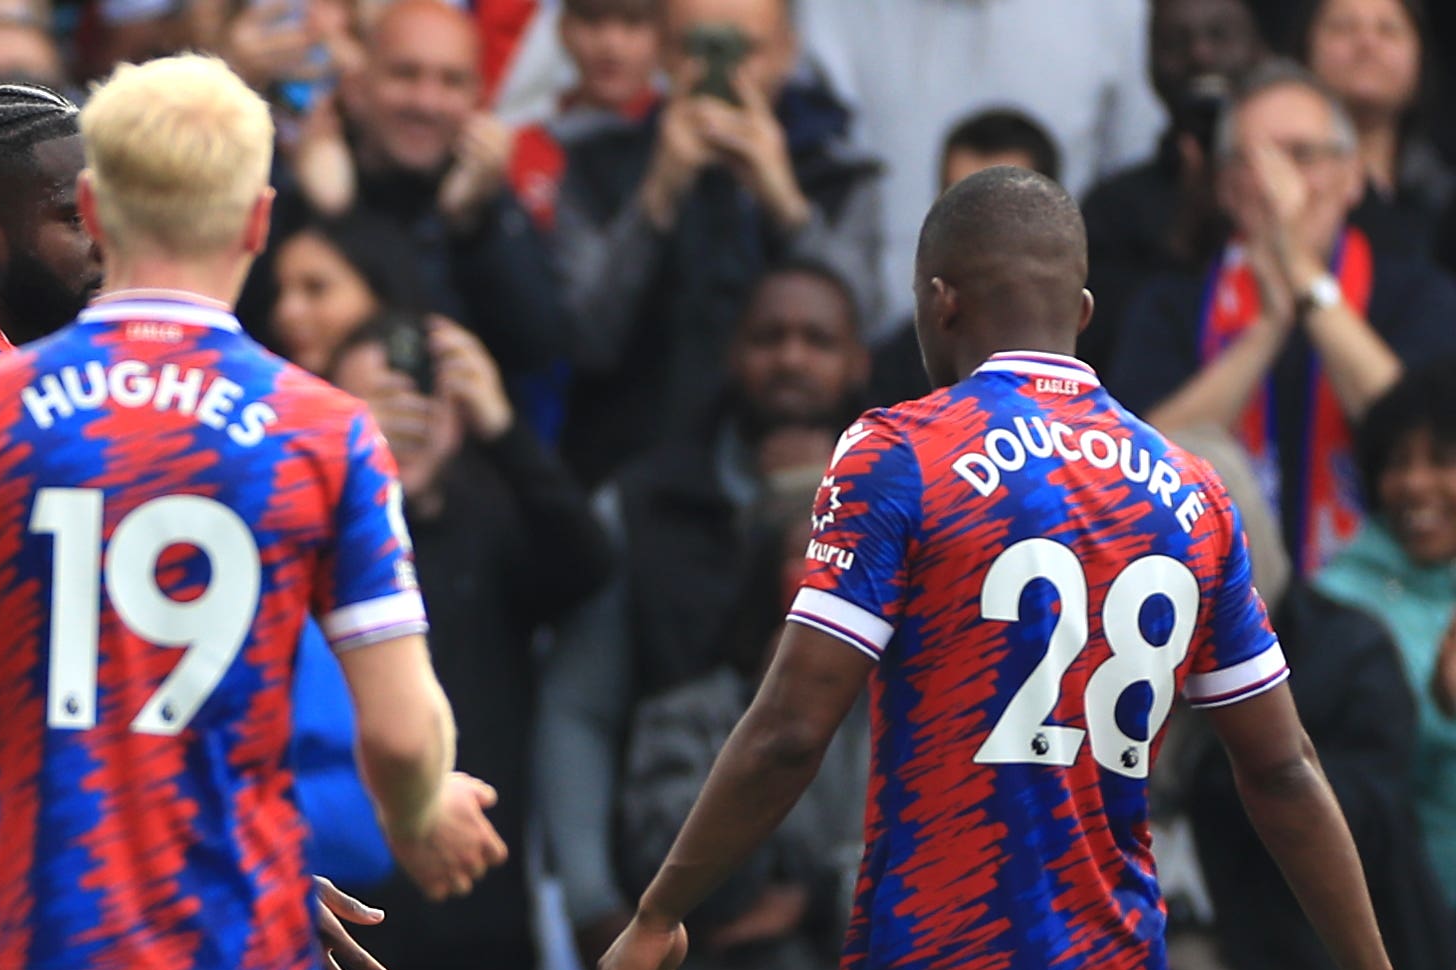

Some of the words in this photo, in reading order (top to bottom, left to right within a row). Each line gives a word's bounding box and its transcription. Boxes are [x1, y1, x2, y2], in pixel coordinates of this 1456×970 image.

[21, 360, 278, 448] HUGHES
[1035, 378, 1079, 396] EAGLES
[29, 487, 262, 736] 19
[973, 537, 1200, 779] 28
